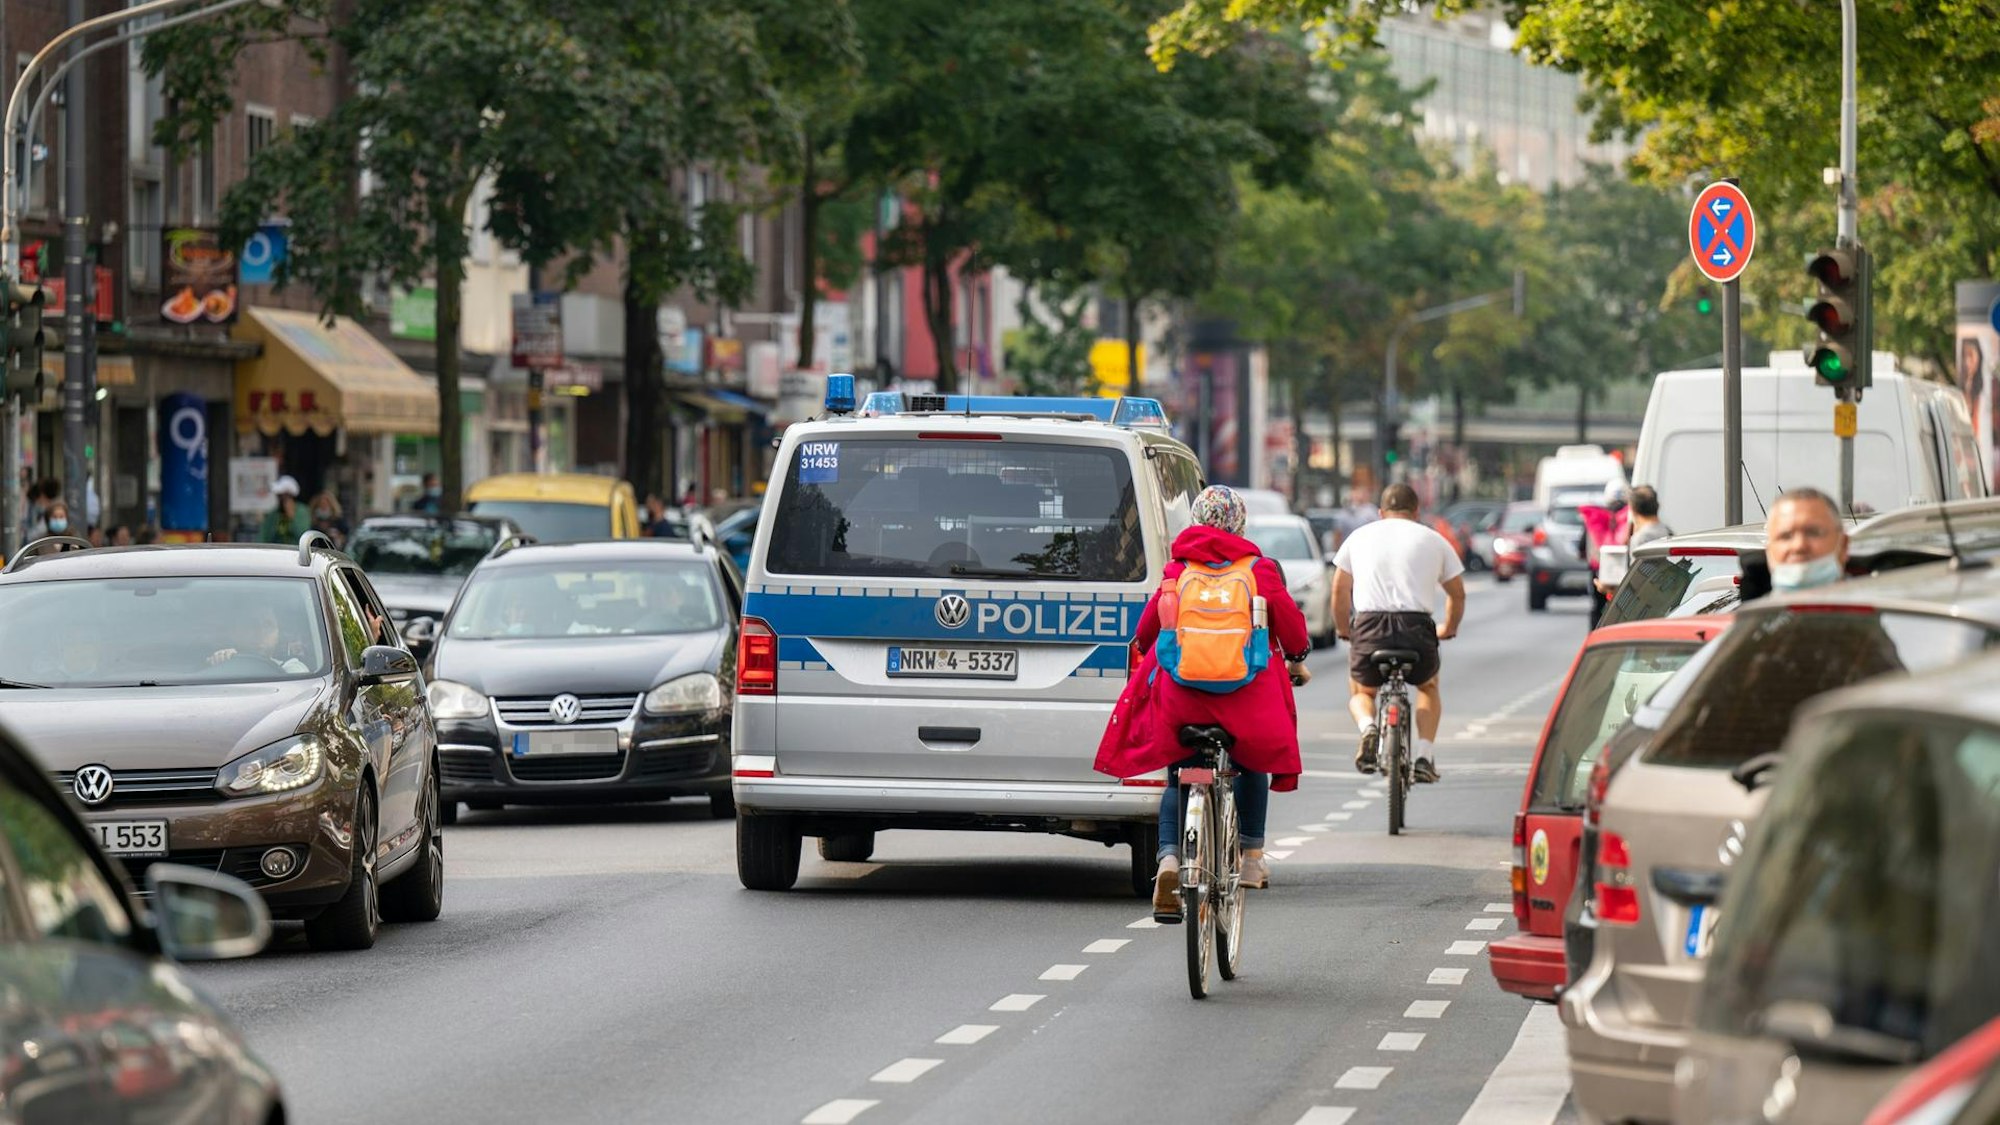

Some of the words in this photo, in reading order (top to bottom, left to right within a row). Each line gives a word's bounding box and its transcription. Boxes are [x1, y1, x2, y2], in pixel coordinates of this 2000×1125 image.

[802, 443, 838, 456] NRW
[801, 457, 838, 469] 31453
[977, 602, 1128, 637] POLIZEI
[900, 650, 936, 670] NRW
[946, 651, 1015, 672] 4-5337
[75, 766, 113, 802] VW
[117, 825, 161, 849] 553
